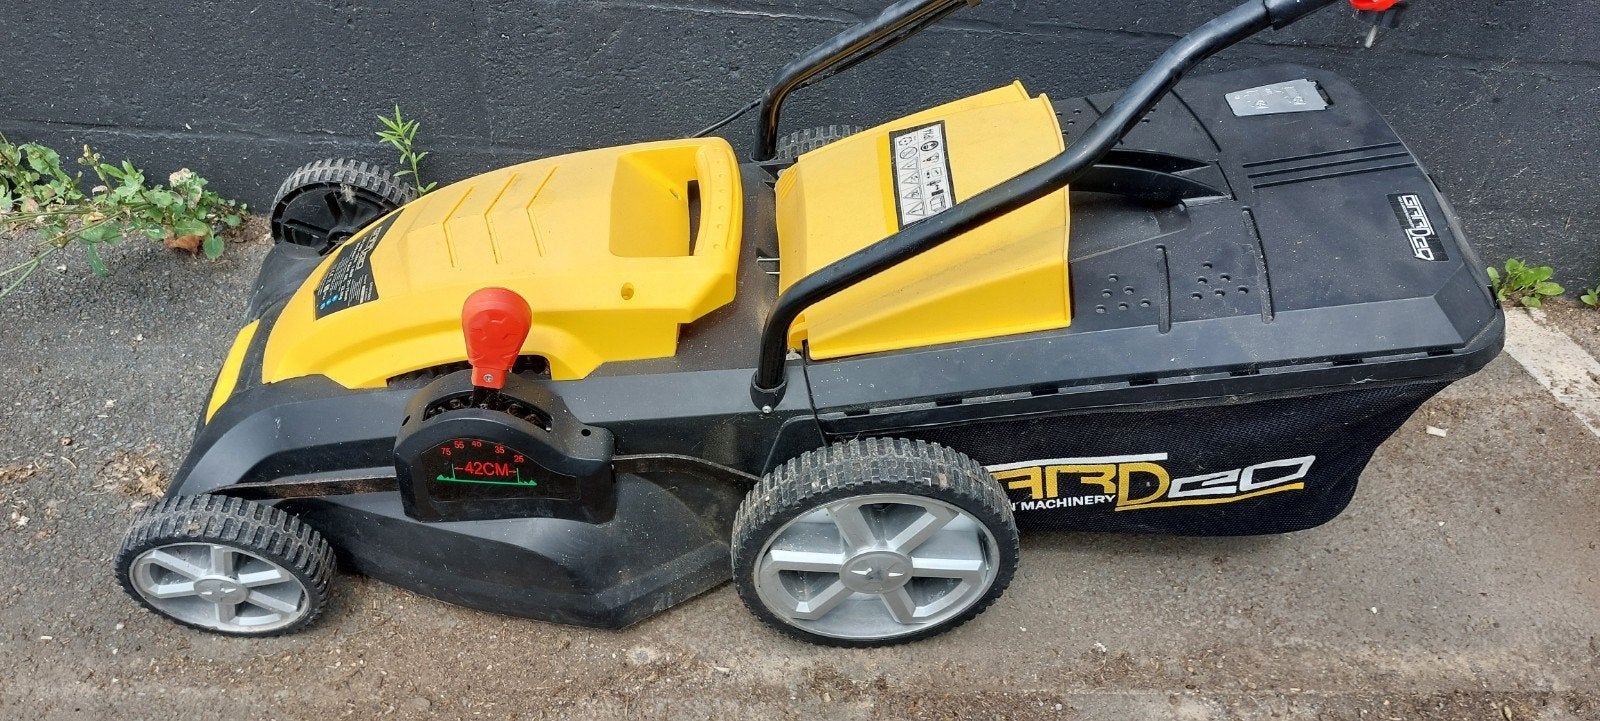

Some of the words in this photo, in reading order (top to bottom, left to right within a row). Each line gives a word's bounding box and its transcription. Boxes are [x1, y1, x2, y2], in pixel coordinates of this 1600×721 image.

[441, 447, 452, 456] 75
[494, 445, 505, 454] 35
[513, 454, 524, 463] 25
[464, 461, 509, 477] 42CM
[1020, 494, 1116, 511] MACHINERY
